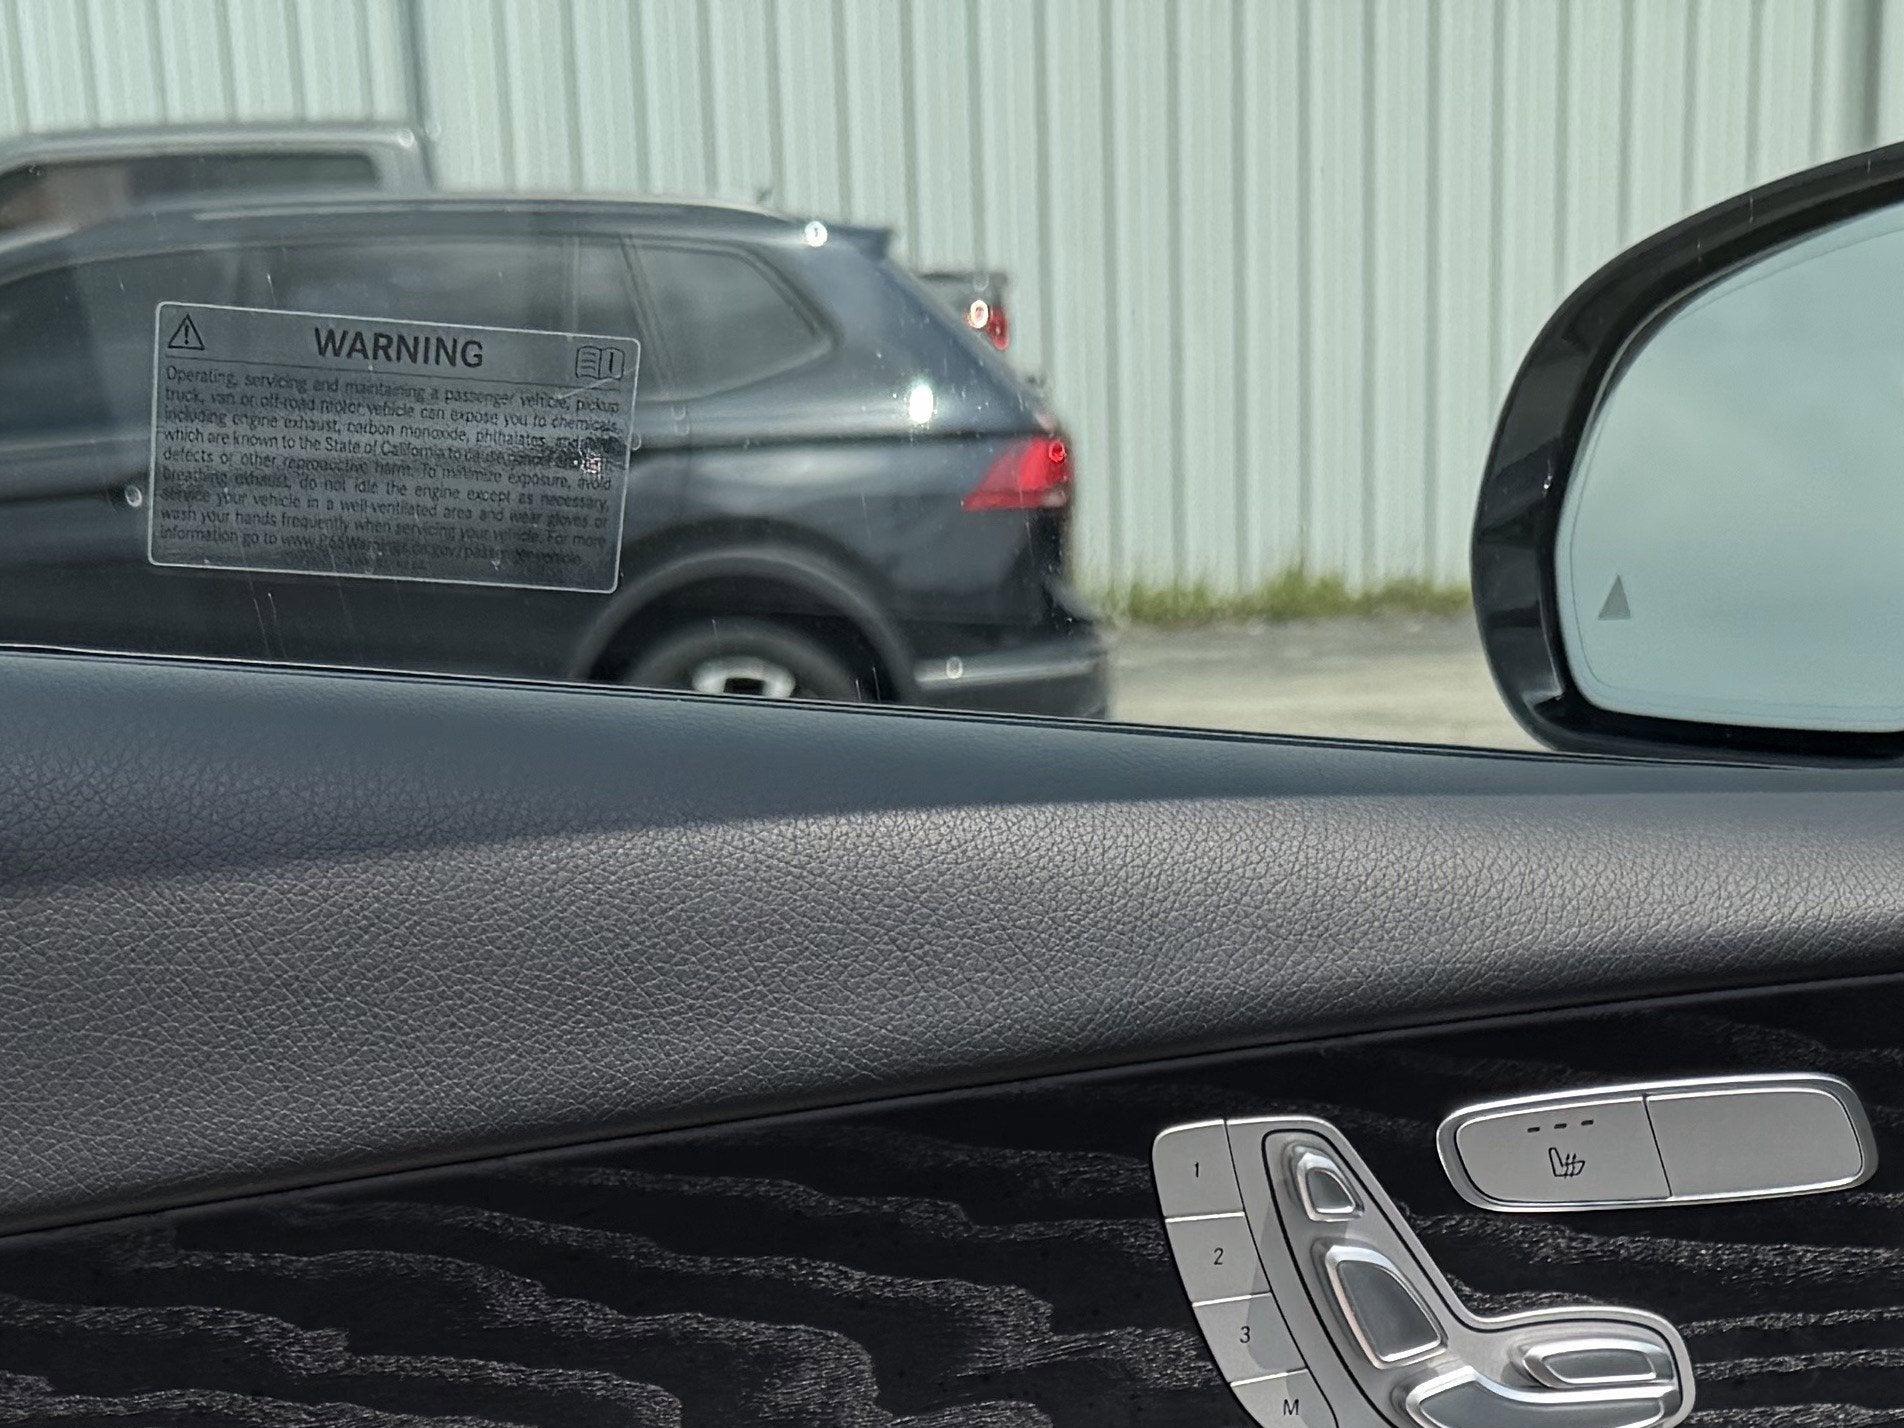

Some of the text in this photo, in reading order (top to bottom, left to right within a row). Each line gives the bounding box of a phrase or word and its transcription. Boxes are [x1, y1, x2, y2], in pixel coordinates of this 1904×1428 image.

[314, 326, 484, 369] WARNING
[312, 375, 338, 392] and
[164, 405, 227, 428] including
[231, 410, 278, 432] engine
[346, 418, 395, 436] carbon
[420, 407, 445, 420] can
[449, 409, 498, 427] expose
[502, 413, 528, 429] you
[532, 412, 547, 427] to
[163, 426, 204, 443] which
[207, 432, 229, 444] are
[232, 430, 277, 448] known
[281, 434, 295, 449] to
[298, 435, 321, 451] the
[324, 437, 360, 453] State
[364, 440, 379, 455] of
[163, 447, 213, 463] defects
[240, 452, 276, 467] other
[299, 475, 318, 490] do
[323, 477, 346, 492] not
[354, 479, 378, 494] idle
[385, 481, 408, 496] the
[413, 483, 460, 503] engine
[465, 486, 511, 506] except
[325, 499, 334, 510] a
[1194, 1161, 1200, 1179] 1
[1213, 1246, 1224, 1266] 2
[1239, 1325, 1251, 1344] 3
[1283, 1398, 1300, 1416] M
